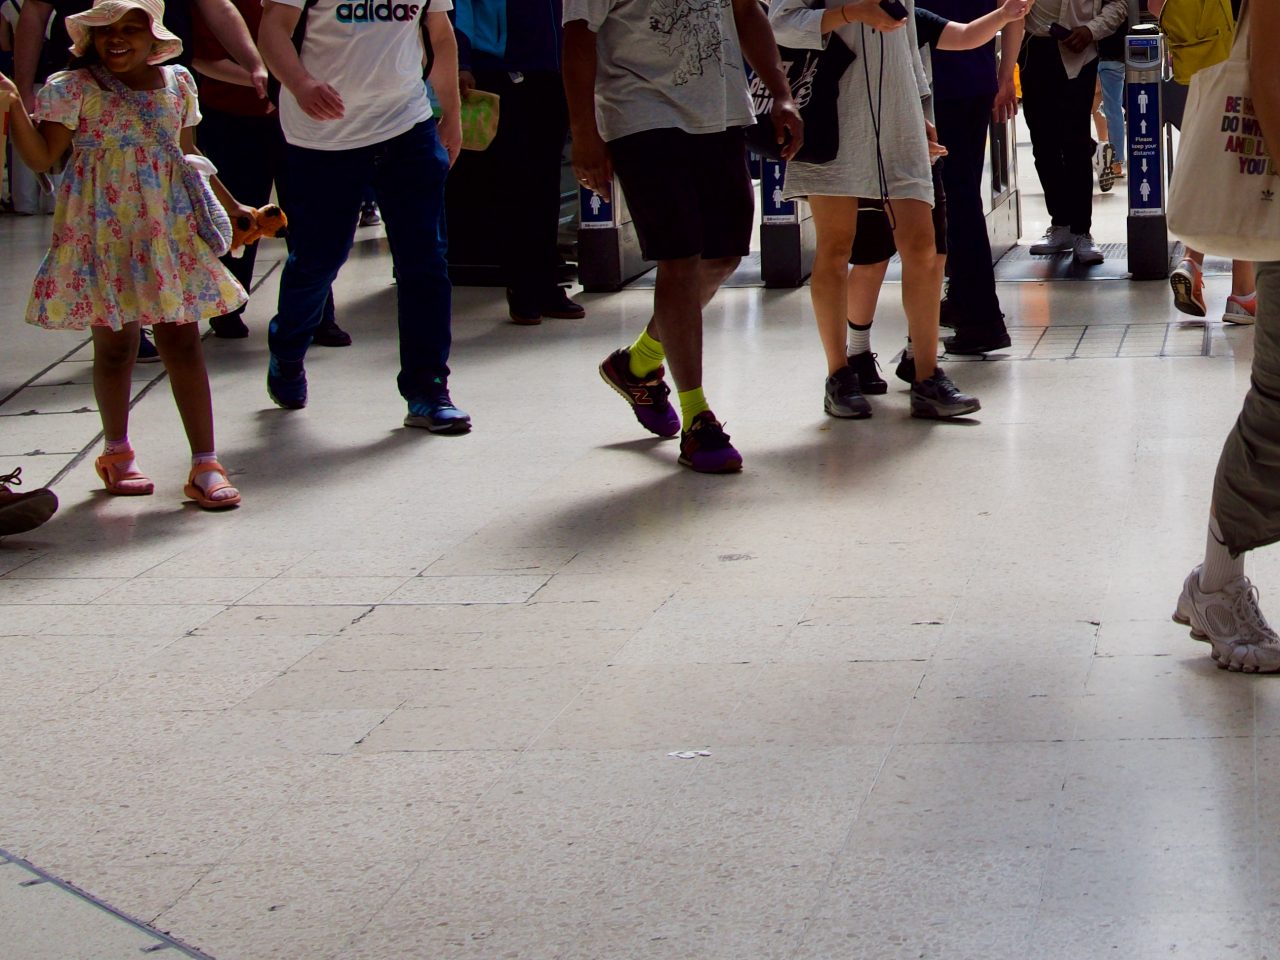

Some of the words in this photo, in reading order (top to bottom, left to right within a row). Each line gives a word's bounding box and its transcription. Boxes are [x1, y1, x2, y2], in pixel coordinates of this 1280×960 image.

[1225, 96, 1241, 113] BE
[1221, 116, 1239, 132] DO
[1225, 136, 1255, 155] AND
[1239, 157, 1266, 174] YOU
